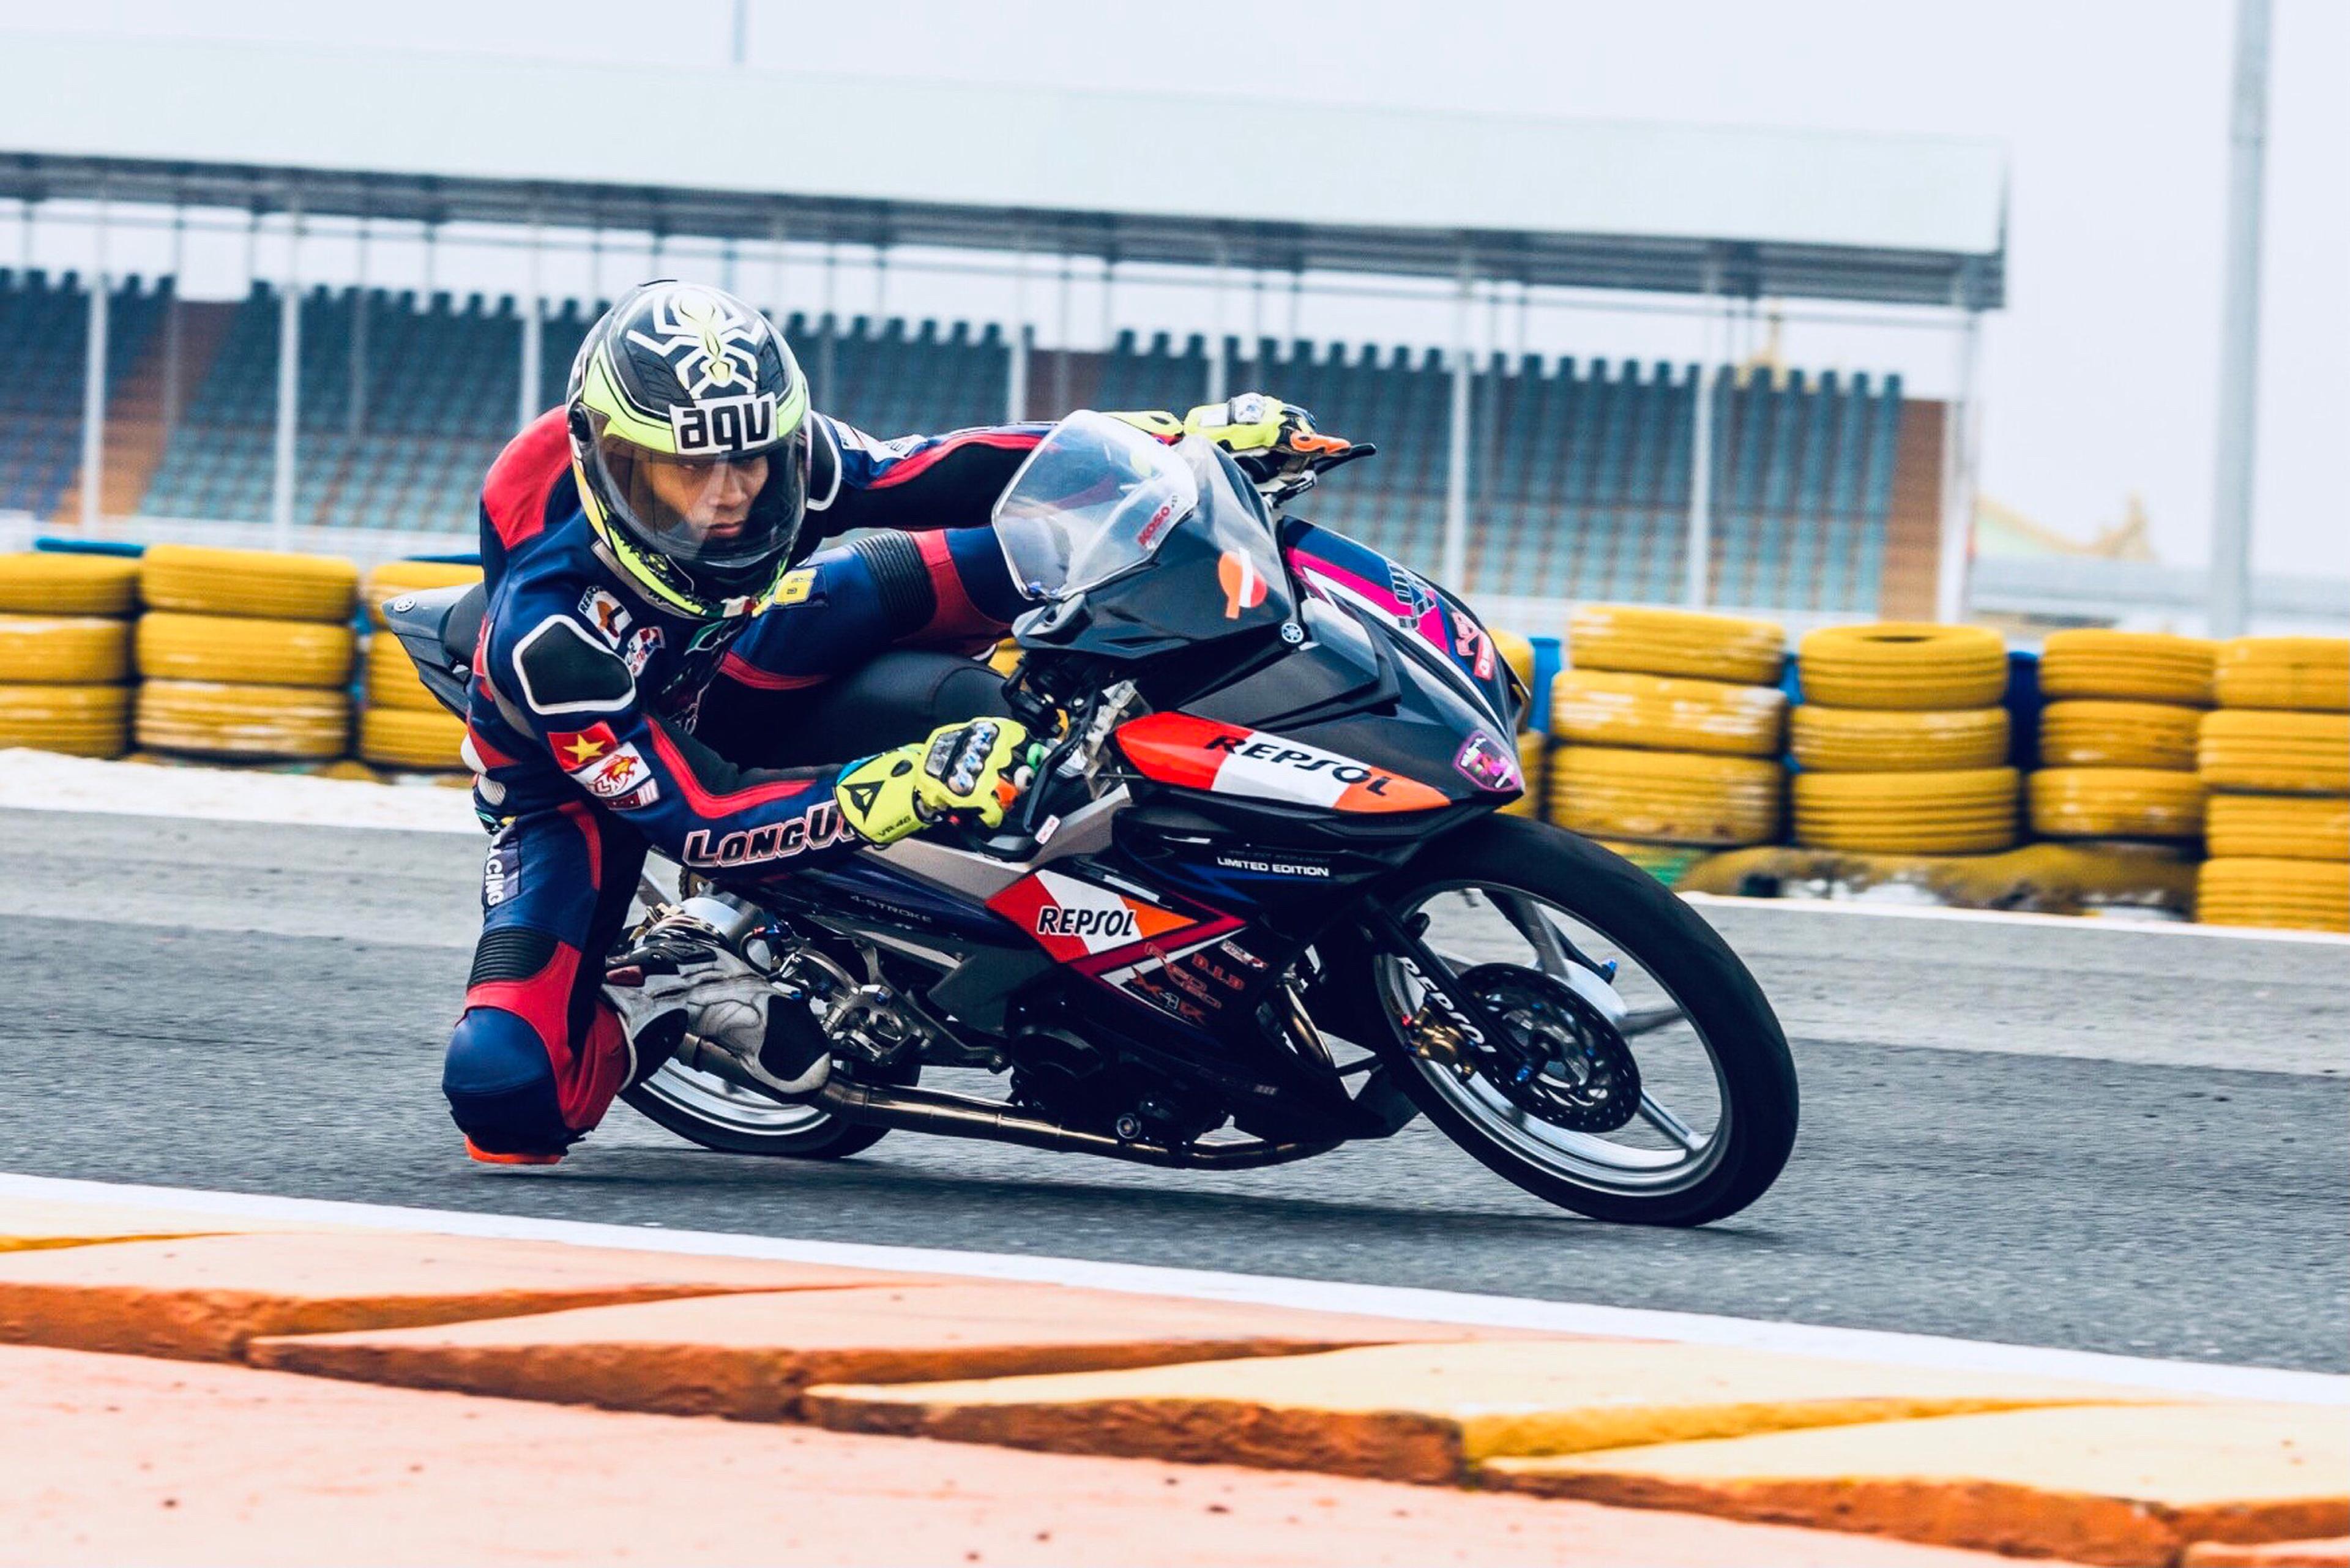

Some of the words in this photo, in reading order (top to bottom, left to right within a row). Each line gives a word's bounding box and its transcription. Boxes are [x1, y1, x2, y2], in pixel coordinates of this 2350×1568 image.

[1203, 734, 1393, 796] REPSOL
[1217, 857, 1269, 872] LIMITED
[1272, 864, 1329, 876] EDITION
[1037, 906, 1136, 937] REPSOL
